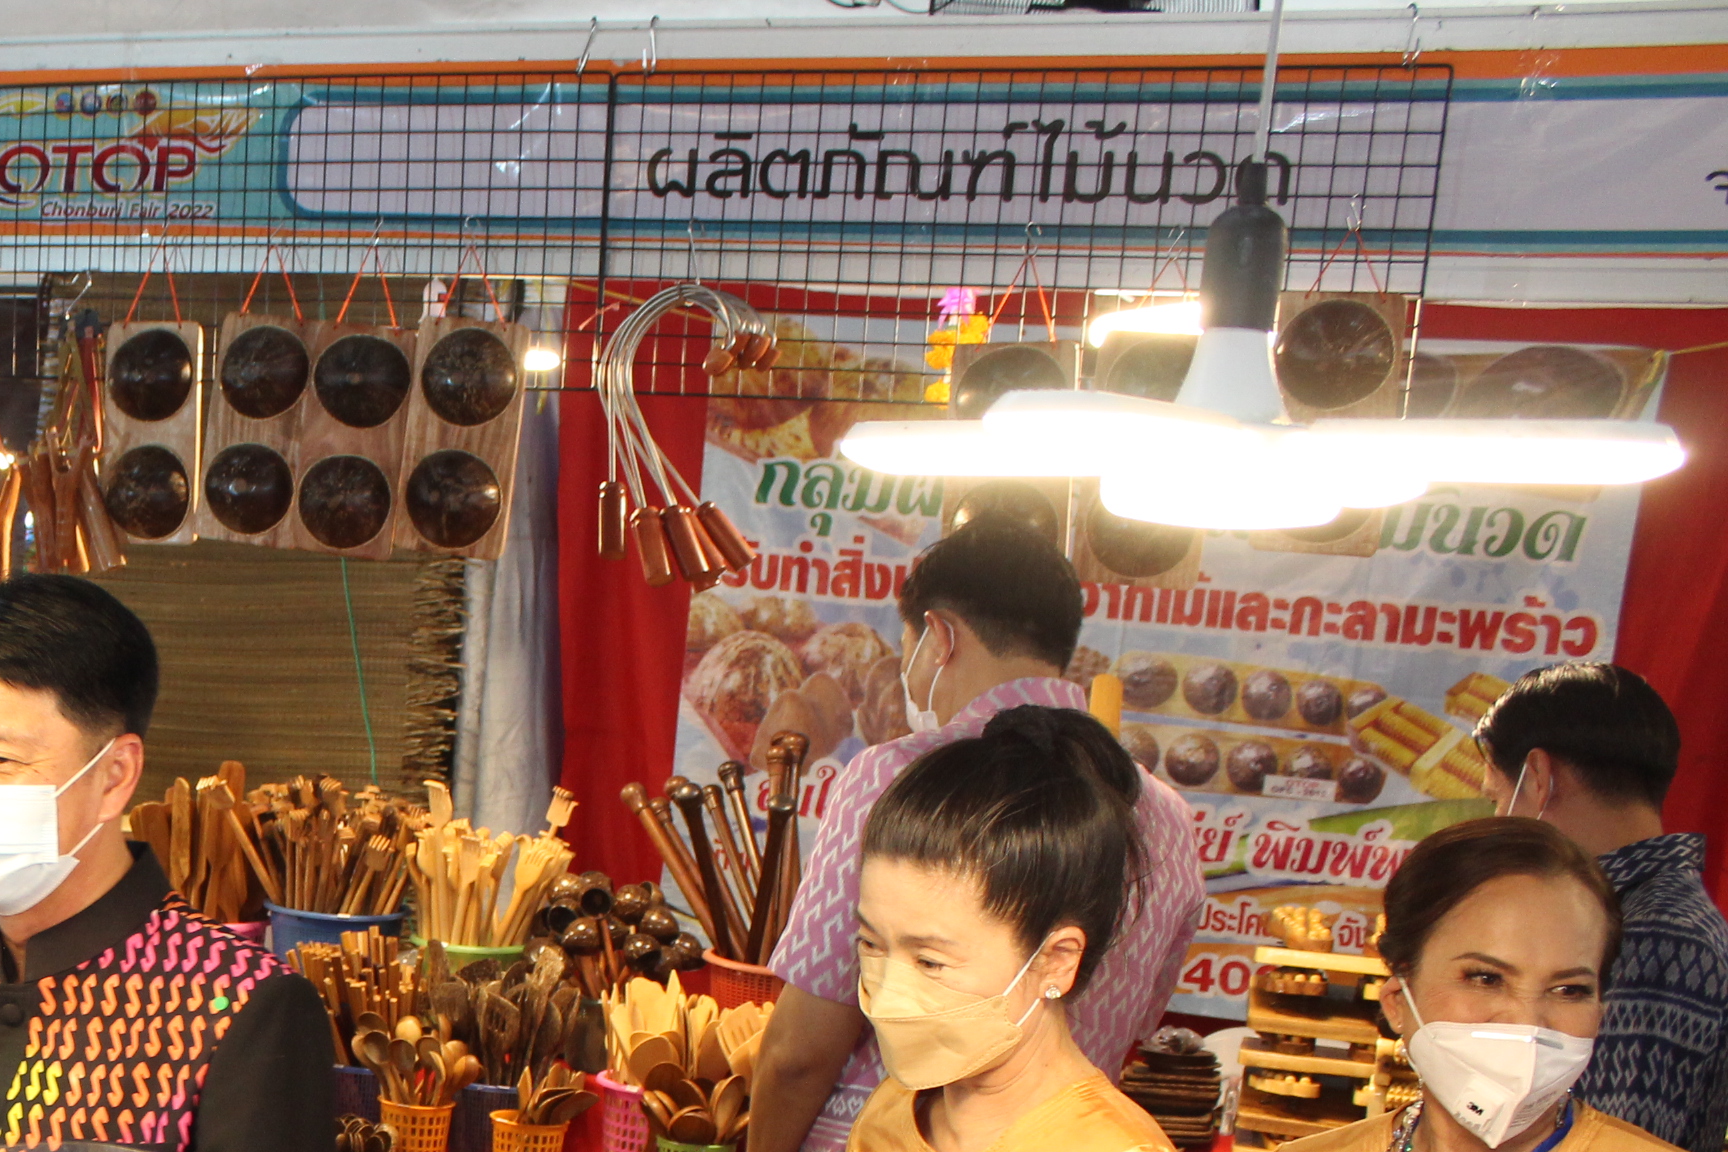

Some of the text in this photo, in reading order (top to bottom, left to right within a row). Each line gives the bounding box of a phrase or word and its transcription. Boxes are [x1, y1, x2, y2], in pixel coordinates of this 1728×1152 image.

[41, 201, 214, 219] Chonburi Fair 2022
